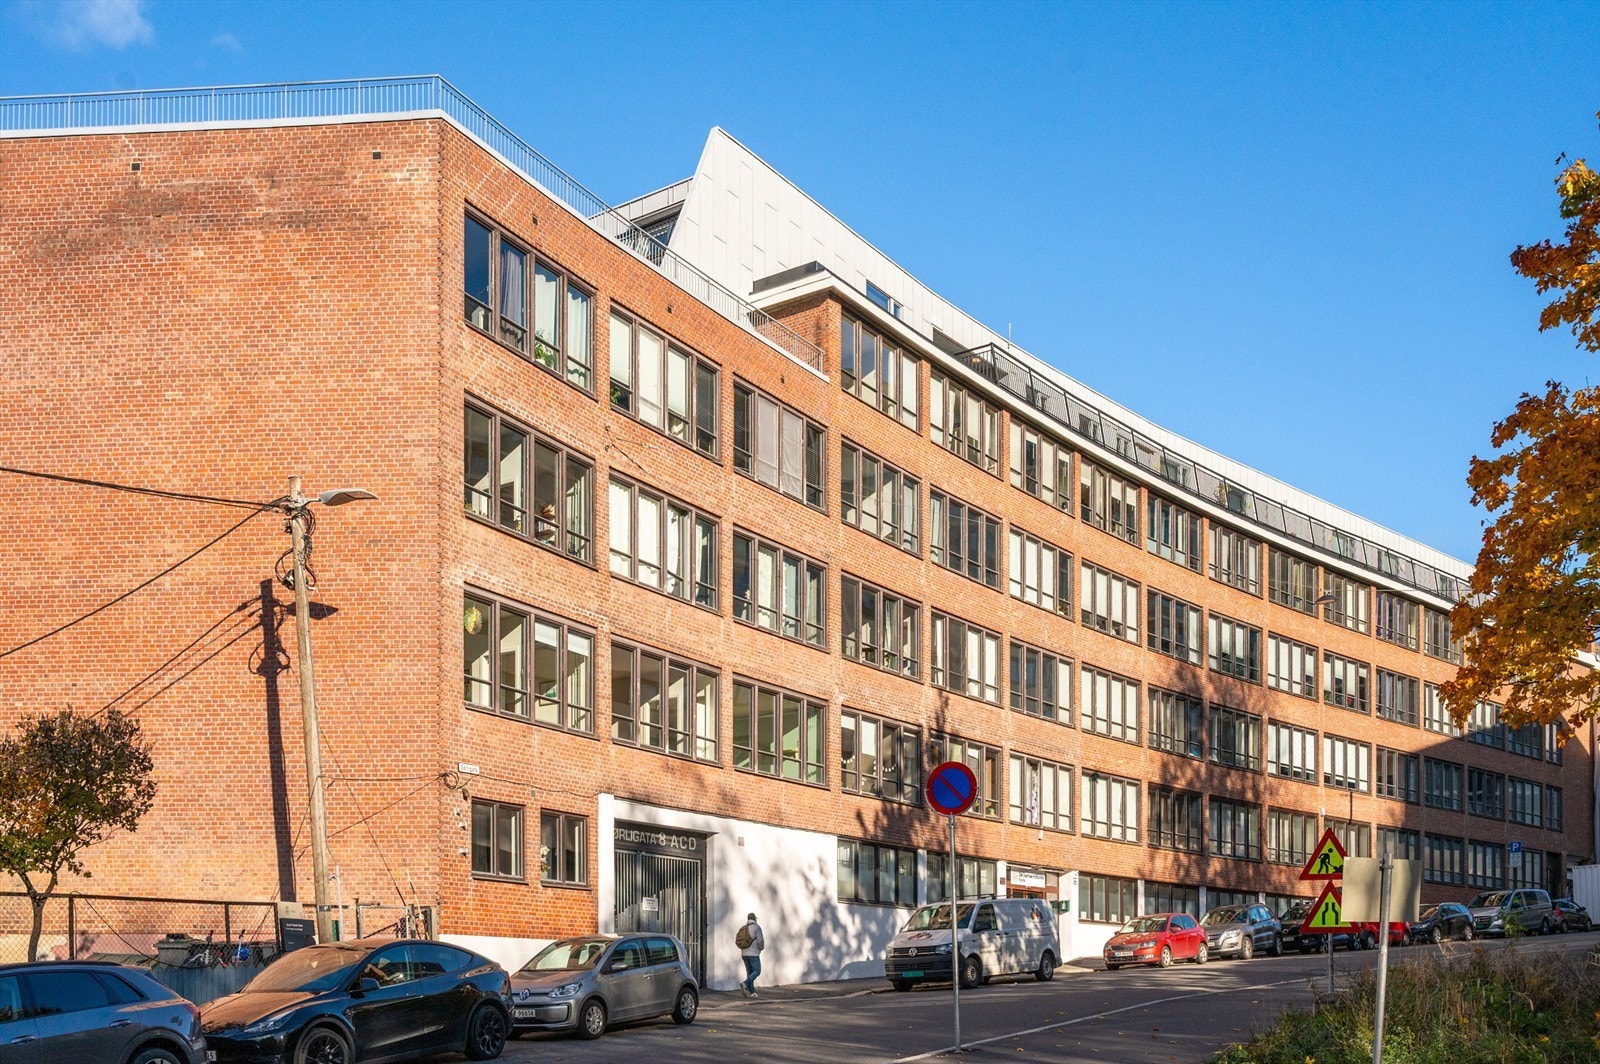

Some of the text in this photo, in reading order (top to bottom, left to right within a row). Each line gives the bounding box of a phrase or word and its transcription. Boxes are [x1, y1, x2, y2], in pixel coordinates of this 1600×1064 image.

[614, 828, 697, 851] ØRLIGATA 8 ACD
[1512, 842, 1519, 852] P
